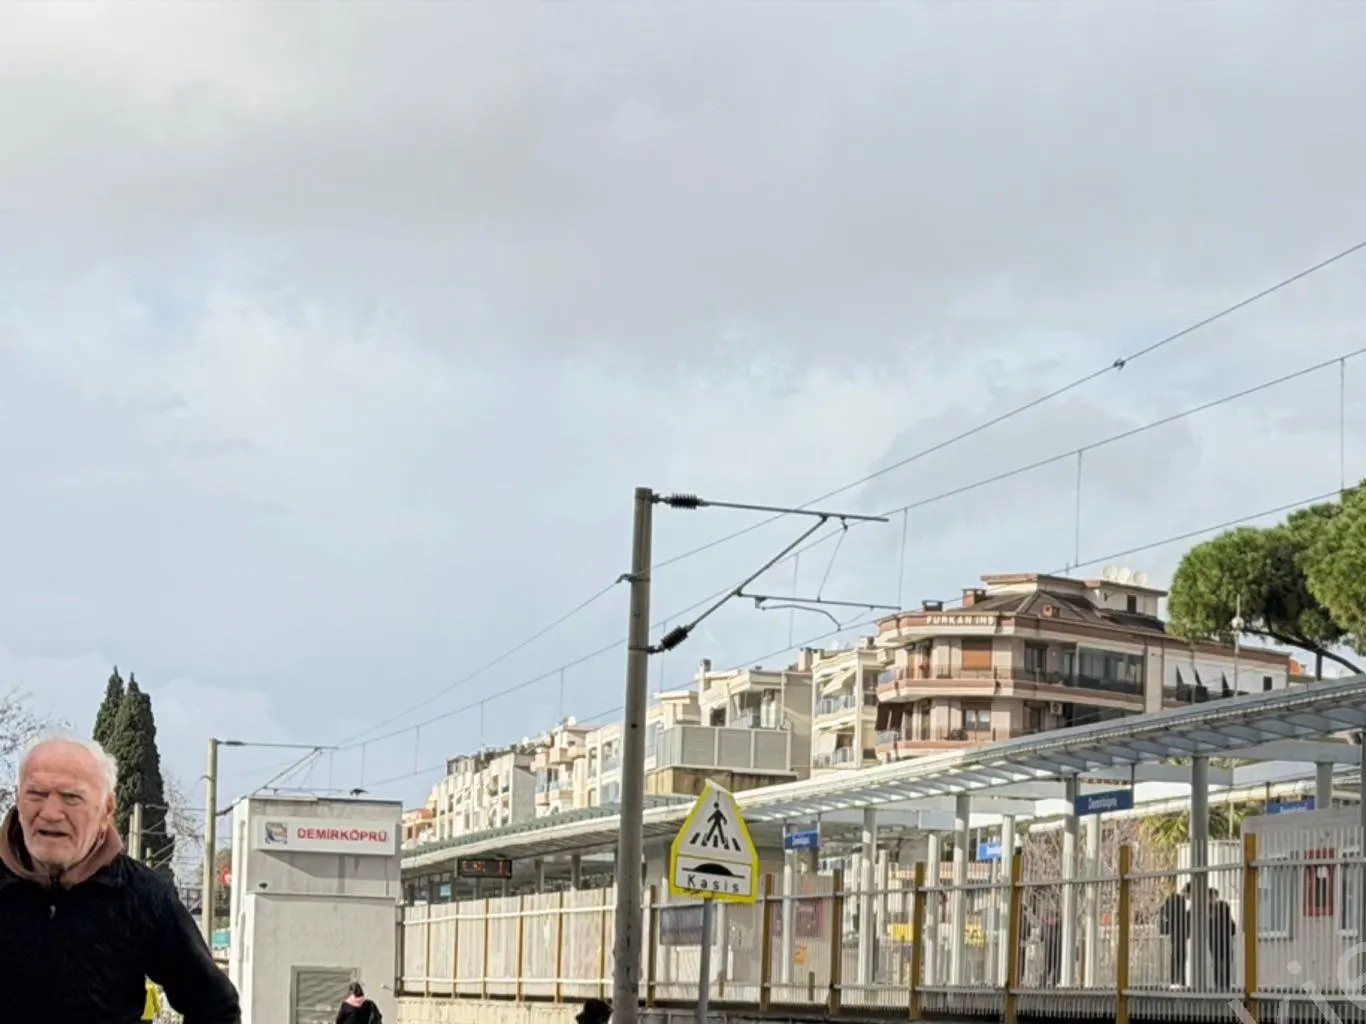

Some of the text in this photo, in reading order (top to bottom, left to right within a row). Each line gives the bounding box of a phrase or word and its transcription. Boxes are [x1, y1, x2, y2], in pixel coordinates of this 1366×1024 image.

[926, 615, 972, 625] FURKAN
[297, 827, 388, 843] DEMİRKÖPRÜ
[687, 874, 740, 893] Kasis
